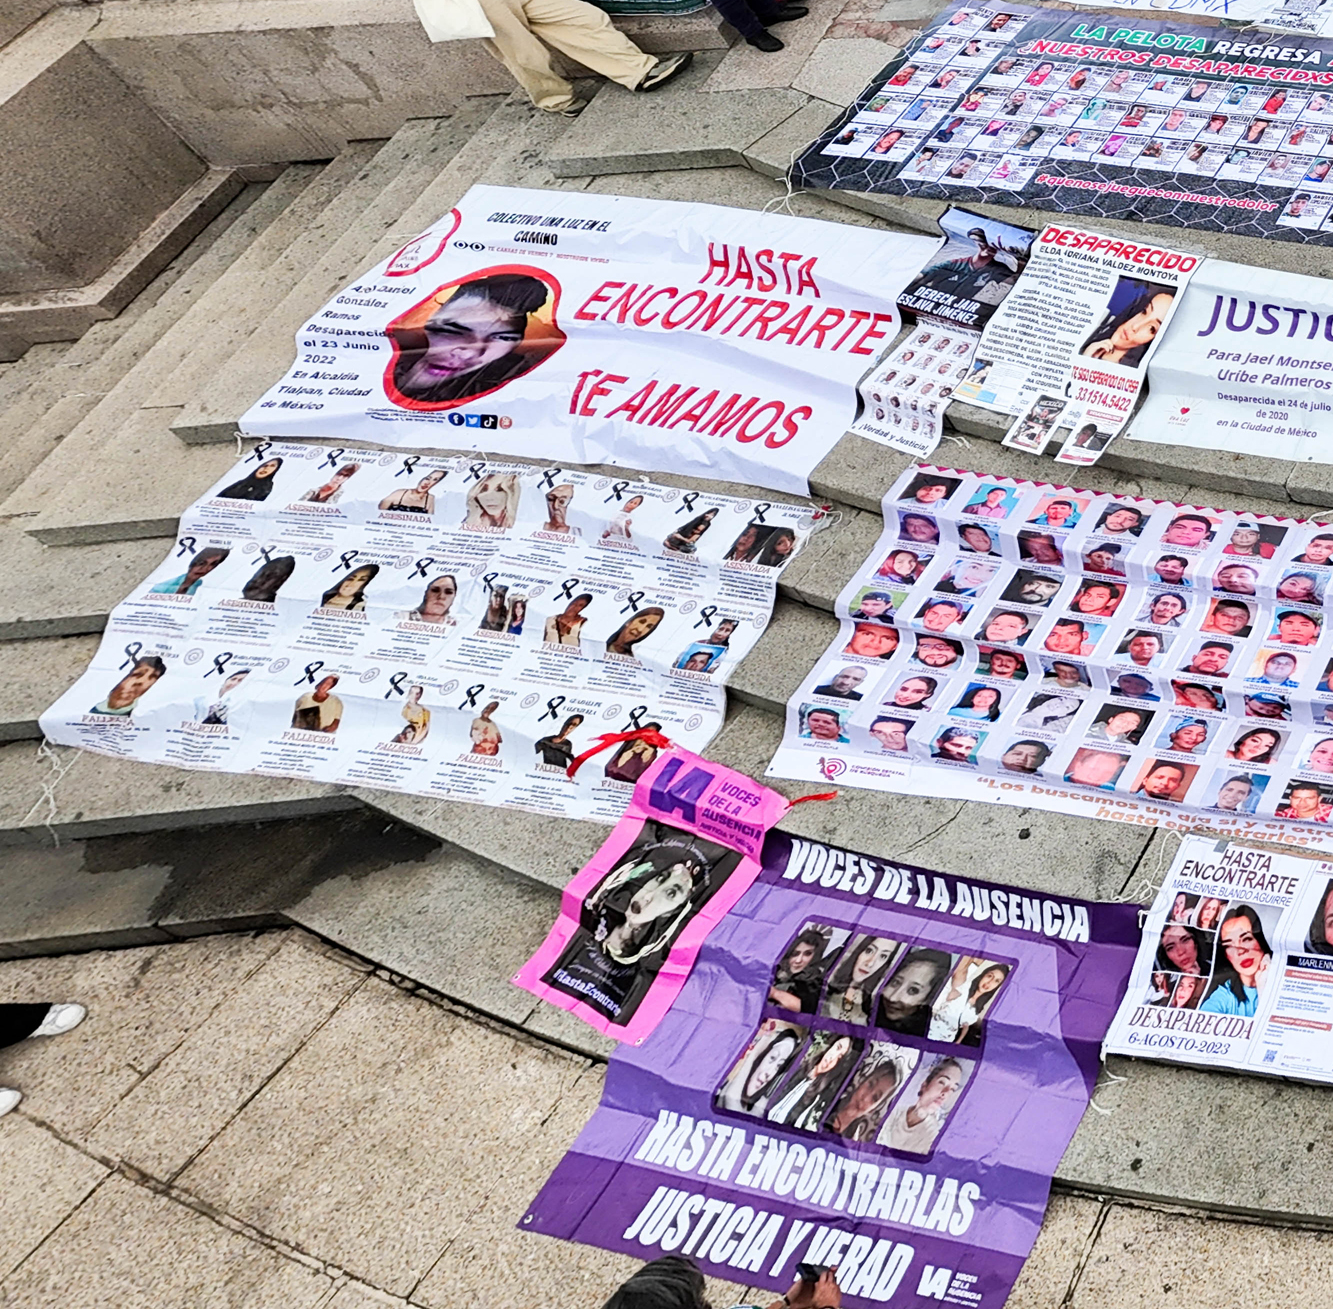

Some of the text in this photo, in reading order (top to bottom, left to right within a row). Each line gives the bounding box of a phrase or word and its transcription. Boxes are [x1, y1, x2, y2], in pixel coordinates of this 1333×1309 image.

[1040, 227, 1197, 273] DESAPARECIDO
[700, 242, 822, 299] HASTA
[572, 281, 893, 357] ENCONTRARTE
[914, 286, 980, 312] DERECK JAIR
[1206, 348, 1242, 362] Para
[1244, 352, 1275, 366] Jael
[1074, 385, 1132, 413] 33.1514.5422
[1217, 368, 1333, 390] Uribe Palmeros
[569, 368, 814, 449] TE AMAMOS
[781, 839, 1091, 943] VOCES DE LA AUSENCIA
[1128, 1006, 1254, 1040] DESAPARECIDA
[1128, 1032, 1231, 1056] 6-AGOSTO-2023
[633, 1109, 981, 1237] HASTA ENCONTRARLAS
